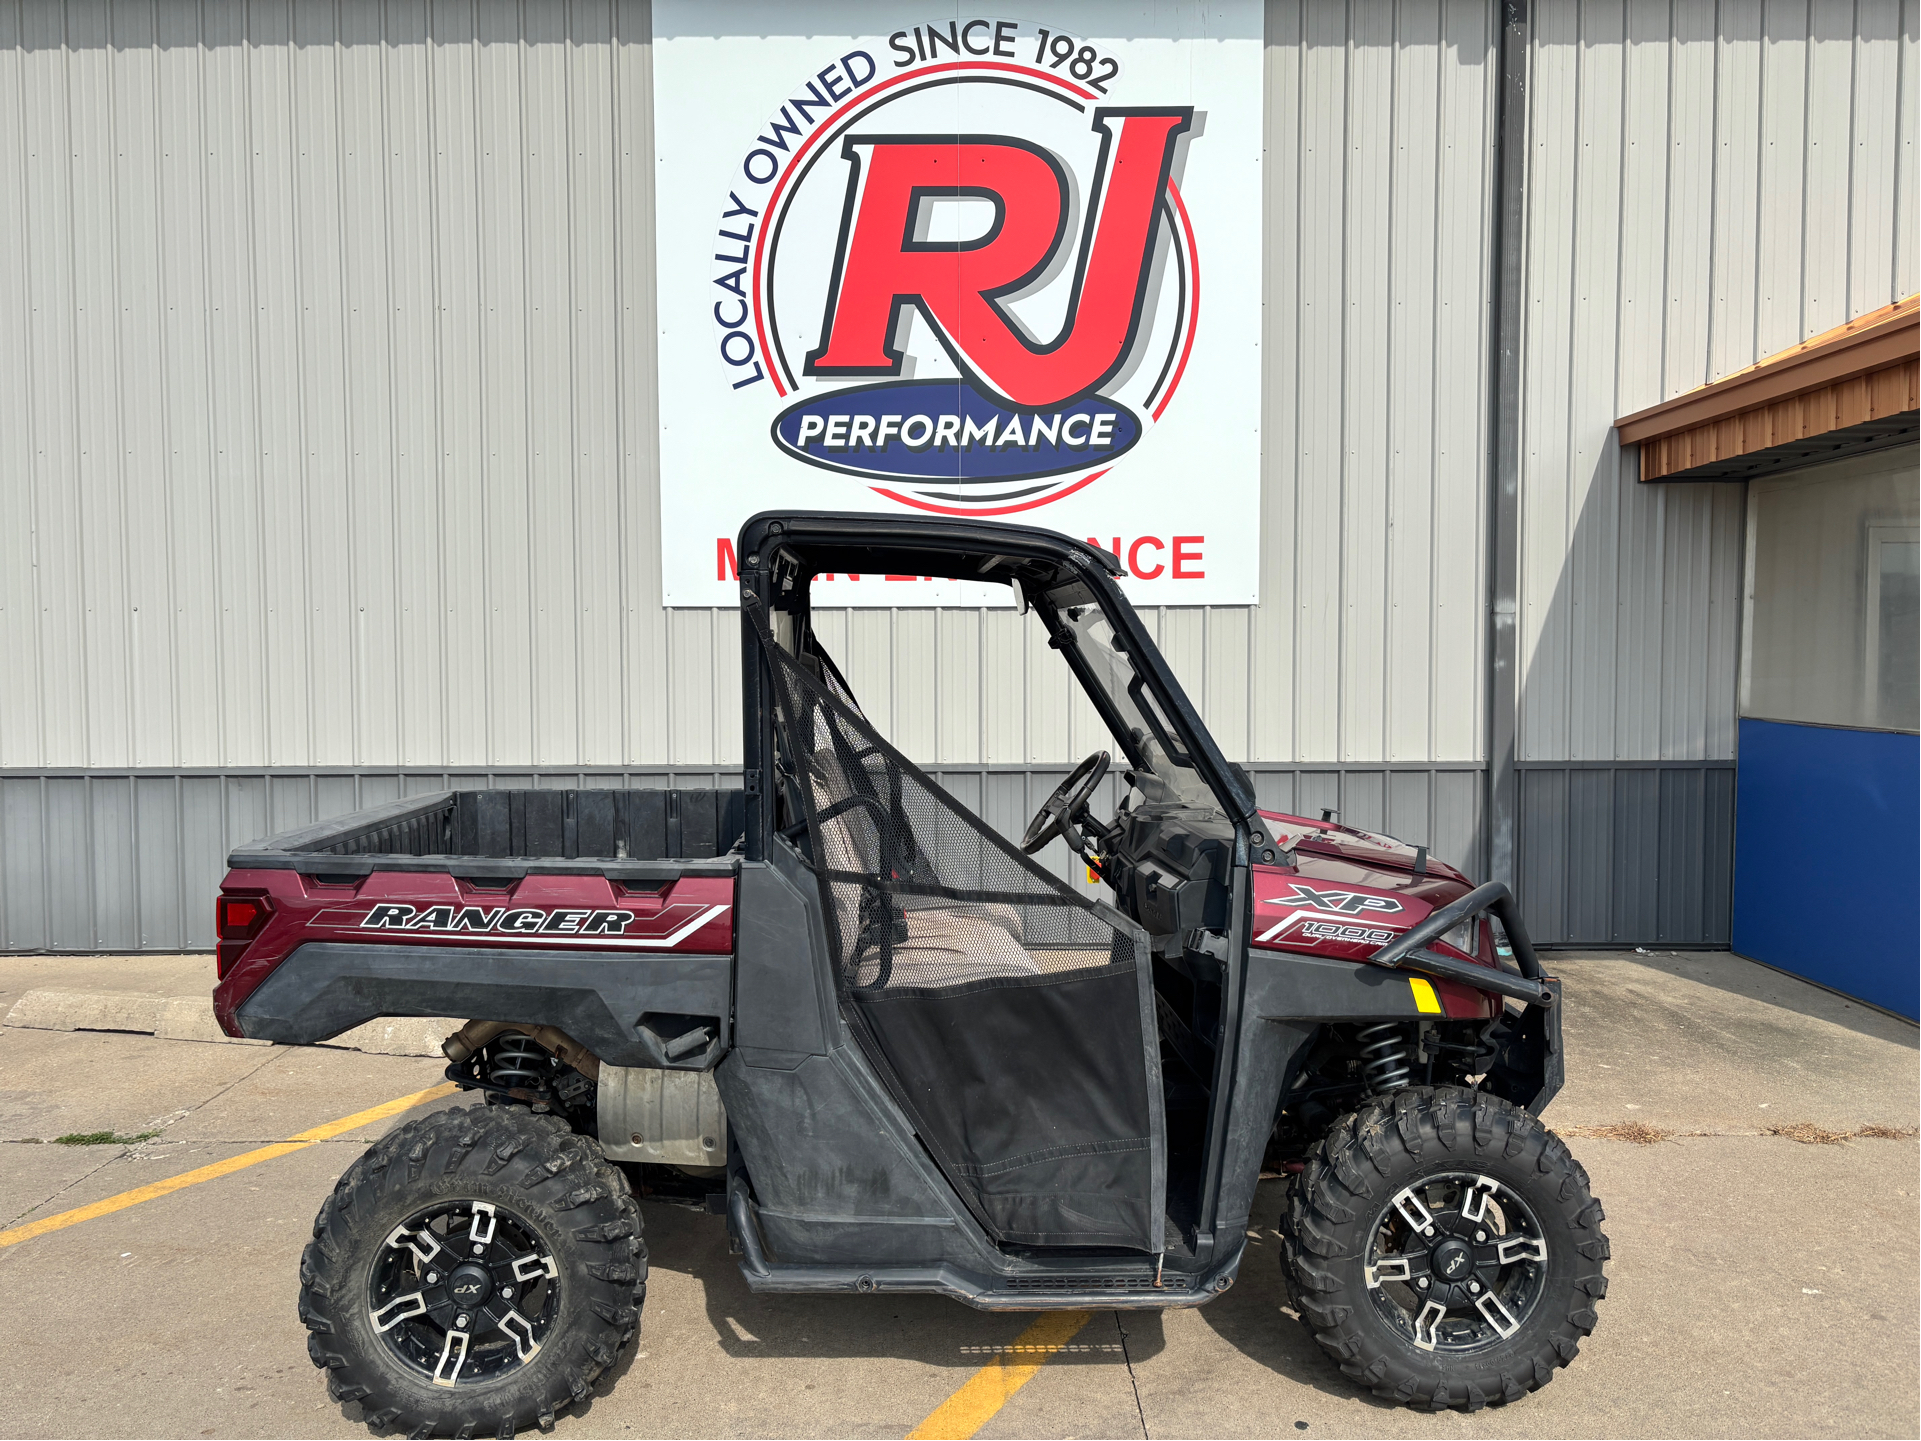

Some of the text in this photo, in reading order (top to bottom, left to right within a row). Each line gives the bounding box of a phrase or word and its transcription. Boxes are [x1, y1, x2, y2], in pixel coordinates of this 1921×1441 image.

[712, 19, 1119, 391] LOCALLY OWNED SINCE 1982
[802, 105, 1195, 415] RJ
[796, 412, 1117, 448] PERFORMANCE
[1262, 883, 1406, 916] XP
[360, 903, 636, 935] RANGER
[1301, 921, 1394, 943] 1000
[1326, 935, 1369, 945] OVERHEAD
[1446, 1251, 1465, 1274] XP
[453, 1284, 482, 1294] XP
